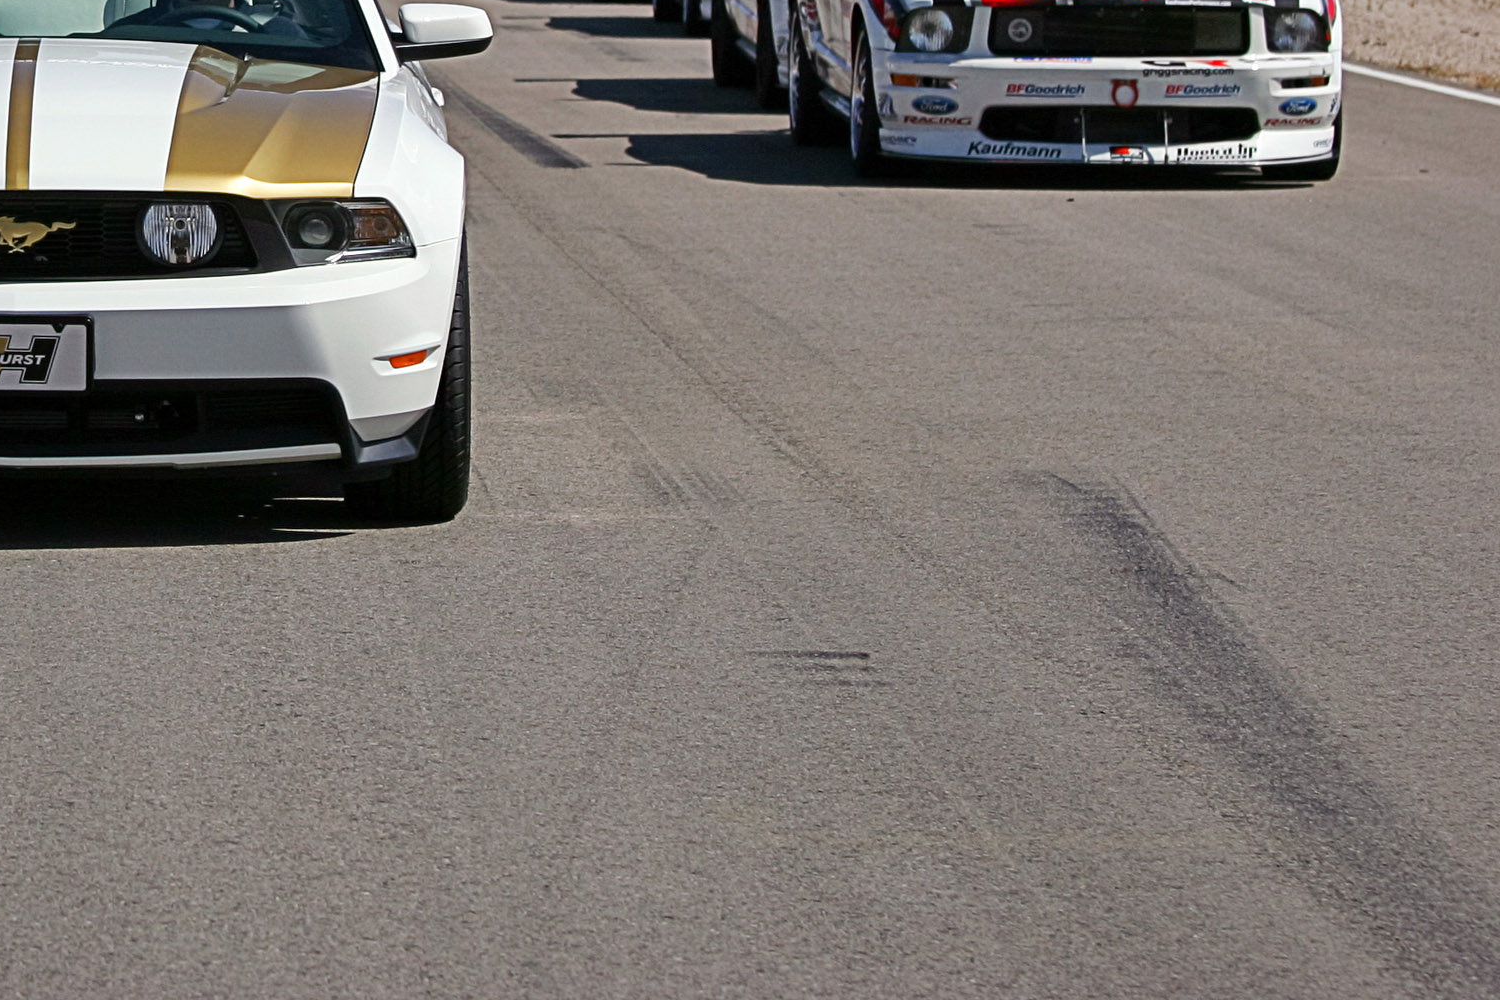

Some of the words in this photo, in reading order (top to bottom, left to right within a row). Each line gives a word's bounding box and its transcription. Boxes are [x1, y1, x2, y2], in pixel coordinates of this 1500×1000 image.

[1142, 67, 1234, 77] griggsracing.com
[1006, 83, 1085, 94] BFGoodrich
[1165, 83, 1240, 94] BFGoodrich
[920, 100, 947, 112] Ford
[1285, 101, 1314, 113] Ford
[904, 115, 972, 125] RACING
[1264, 116, 1323, 127] RACING
[967, 141, 1061, 159] Kaufmann
